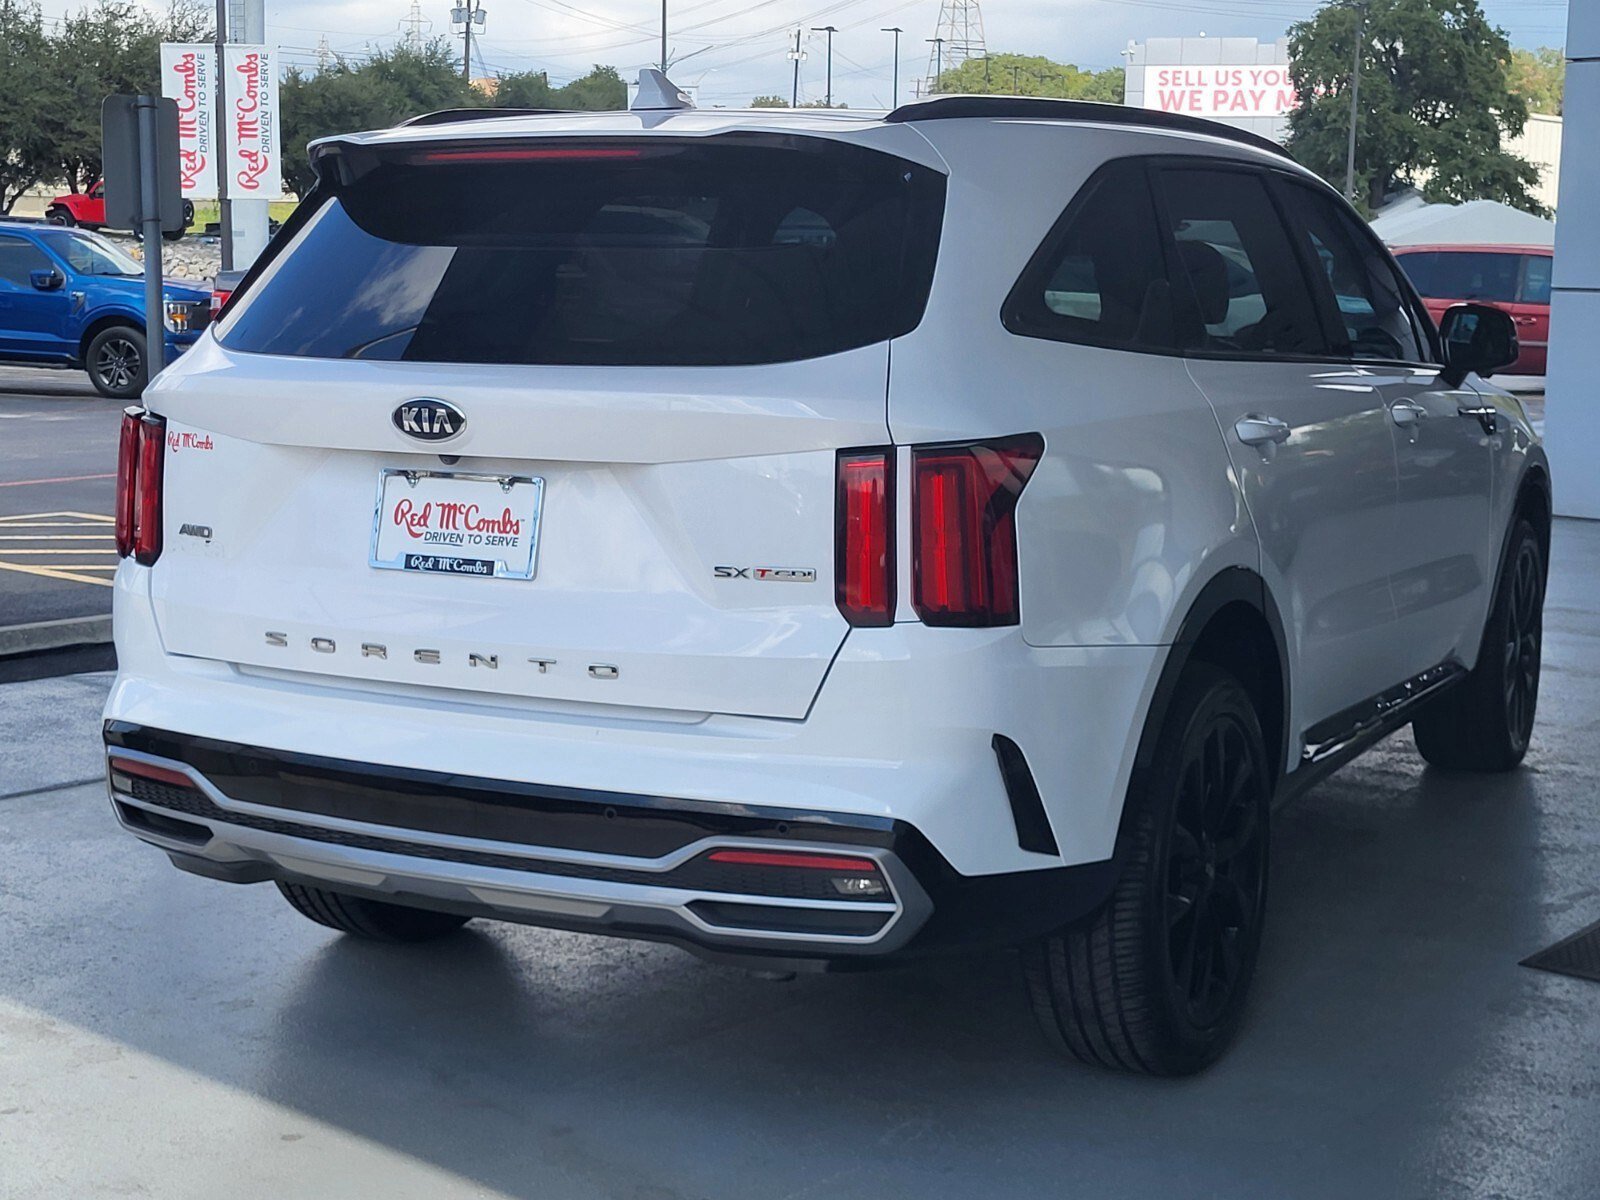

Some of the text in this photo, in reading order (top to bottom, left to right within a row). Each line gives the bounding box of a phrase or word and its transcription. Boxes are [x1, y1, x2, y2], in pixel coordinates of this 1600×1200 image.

[1158, 70, 1295, 87] SELL US YOU
[197, 53, 208, 153] DRIVEN TO SERVE
[260, 53, 270, 153] DRIVEN TO SERVE
[1158, 90, 1202, 111] WE
[1213, 90, 1266, 112] PAY
[236, 53, 269, 190] Red McCombs
[402, 407, 454, 433] KIA
[168, 431, 213, 452] Red McCombs
[394, 499, 520, 538] Red McCombs
[179, 524, 213, 538] AWD
[424, 531, 519, 547] DRIVEN TO SERVE
[411, 555, 487, 574] Red McCombs
[714, 566, 750, 579] SX
[265, 631, 619, 680] SORENTO
